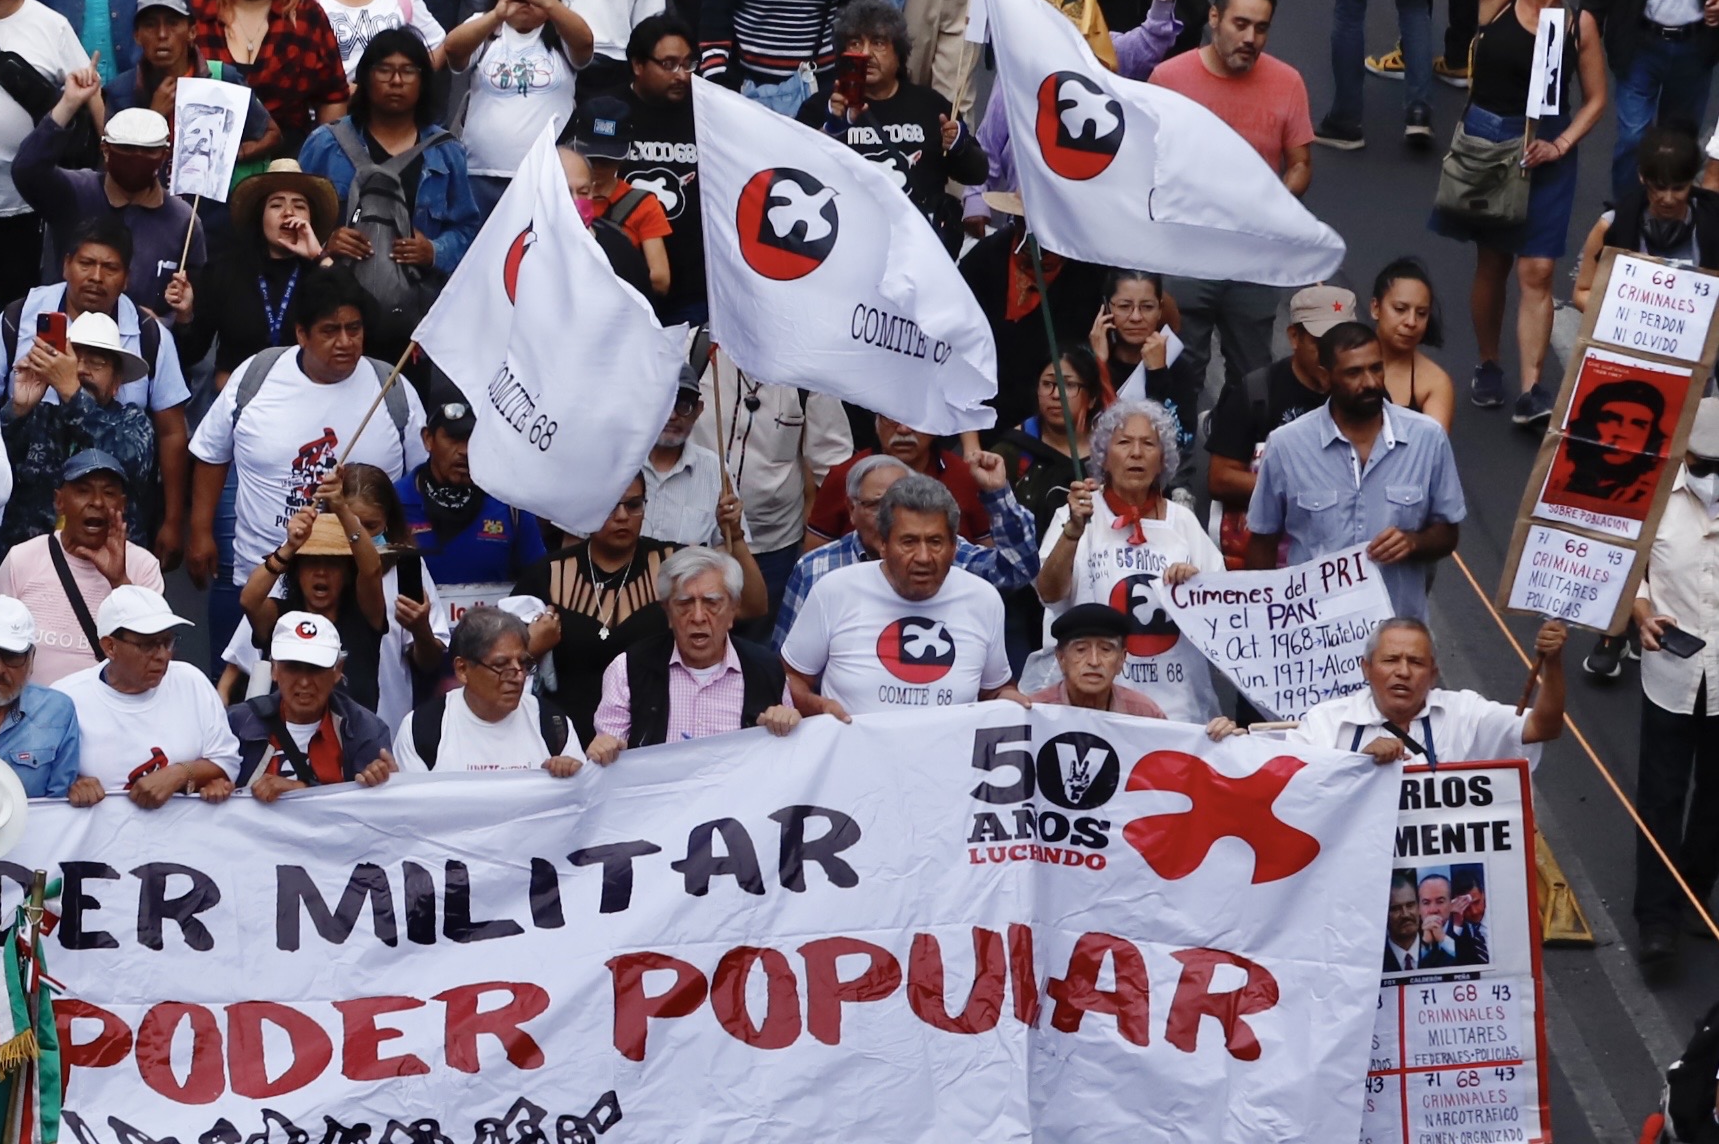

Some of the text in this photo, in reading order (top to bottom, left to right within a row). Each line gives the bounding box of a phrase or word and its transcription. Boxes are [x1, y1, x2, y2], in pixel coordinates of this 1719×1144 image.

[1625, 263, 1710, 297] 71 68 43
[1617, 283, 1696, 315] CRIMINALES
[1640, 309, 1686, 336] PERDON
[1614, 327, 1679, 354] NI OLVIDO
[529, 412, 559, 453] 68
[1548, 503, 1630, 533] SOBRE POBLACION
[1115, 547, 1135, 569] 55
[1538, 532, 1623, 566] 71 68 43
[1283, 572, 1308, 602] del
[1319, 553, 1369, 596] PRI
[1531, 551, 1611, 584] CRIMINALES
[1527, 571, 1599, 602] MILITARES
[1229, 607, 1249, 630] el
[1525, 591, 1583, 619] POLICIAS
[1270, 629, 1315, 656] 1968
[1166, 662, 1185, 684] 68
[1273, 657, 1315, 687] 1971
[878, 684, 953, 706] COMITÉ 68
[1276, 685, 1321, 711] 1995
[275, 804, 862, 953] MILITAR
[1420, 983, 1512, 1005] 71 68 43
[1418, 1005, 1506, 1026] CRIMINALES
[60, 980, 552, 1105] PODER
[1428, 1024, 1508, 1047] MILITARES
[1424, 1072, 1442, 1088] 71
[1455, 1070, 1481, 1090] 68
[1494, 1066, 1517, 1083] 43
[1422, 1088, 1509, 1110] CRIMINALES
[1424, 1106, 1519, 1129] NARCOTRAFICO
